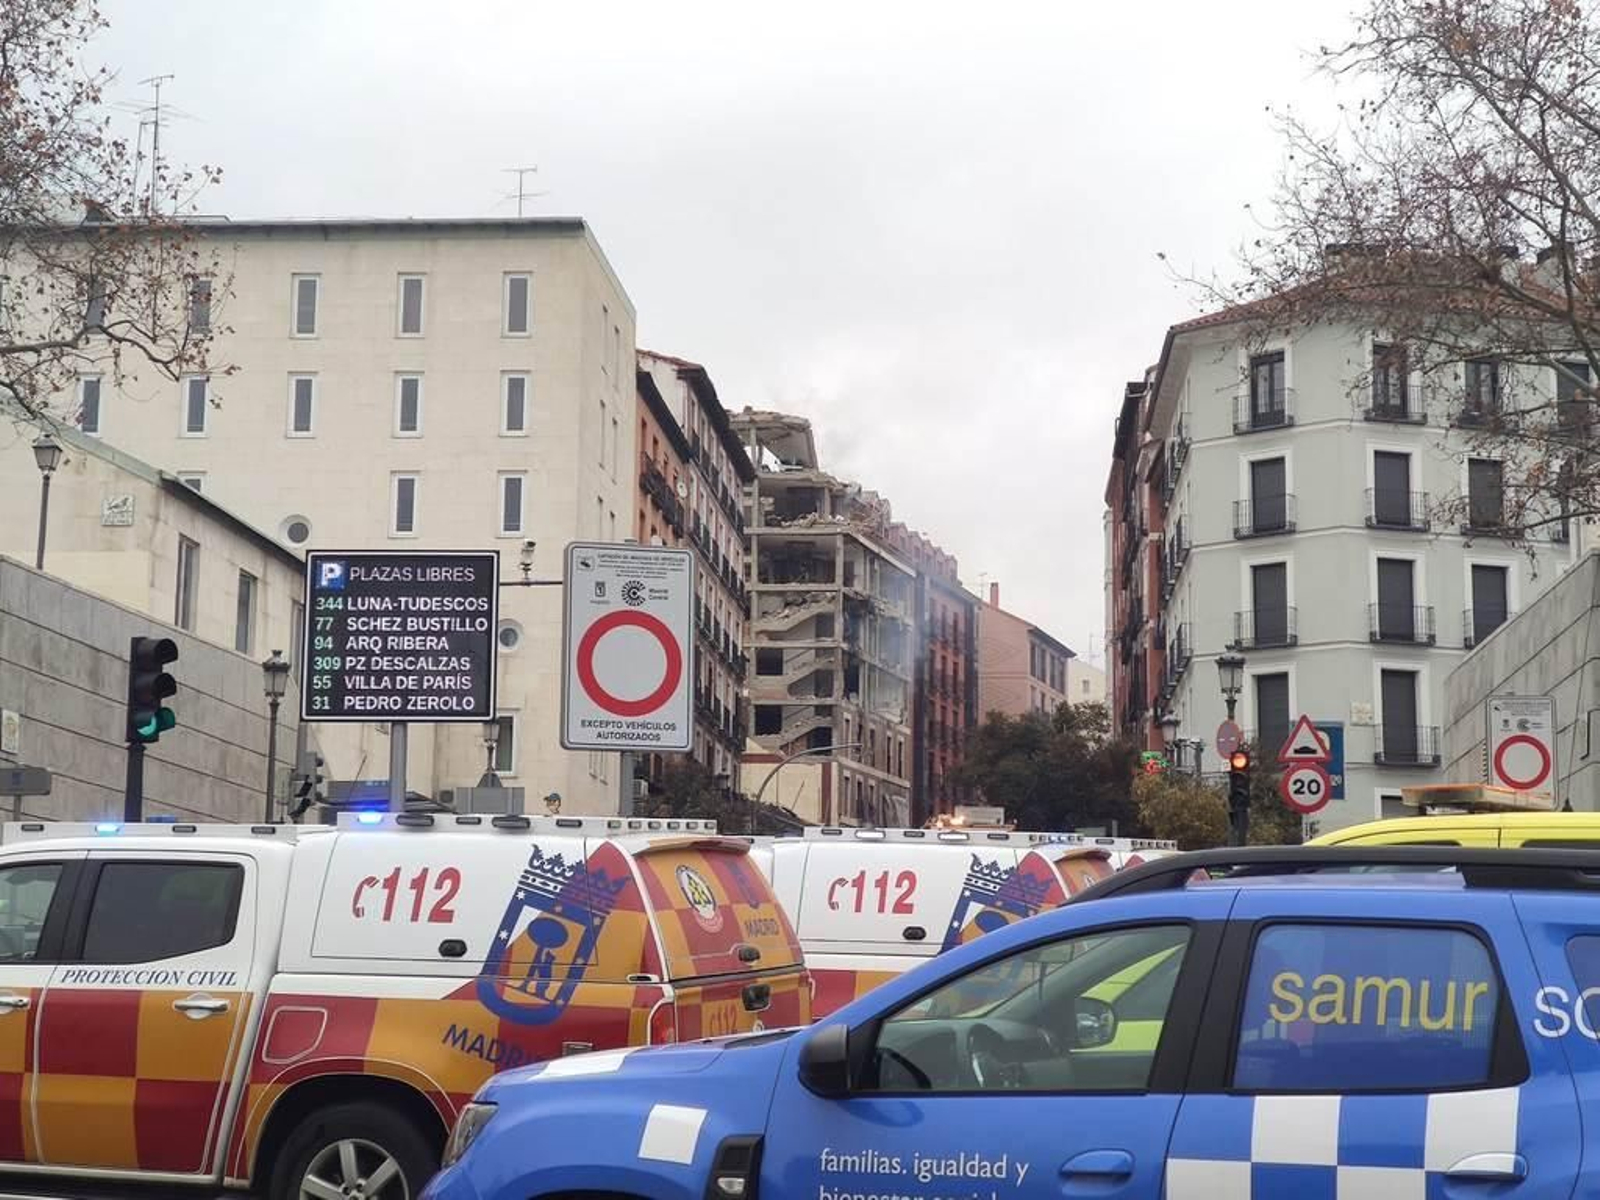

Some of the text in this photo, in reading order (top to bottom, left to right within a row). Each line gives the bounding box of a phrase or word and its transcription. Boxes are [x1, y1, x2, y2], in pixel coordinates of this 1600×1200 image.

[321, 563, 475, 587] P PLAZAS LIBRES
[315, 597, 489, 611] 344 LUNA-TUDESCOS
[315, 617, 488, 632] 77 SCHEZ BUSTILLO
[314, 636, 449, 654] 94 ARQ RIBERA
[313, 657, 471, 670] 309 PZ DESCALZAS
[312, 672, 472, 689] 55 VILLA DE PARÍS
[312, 696, 476, 710] 31 PEDRO ZEROLO
[580, 719, 624, 729] EXCEPTO
[596, 731, 662, 741] AUTORIZADOS
[1292, 778, 1321, 795] 20
[381, 866, 461, 923] 112
[851, 869, 918, 915] 112
[61, 969, 238, 986] PROTECCION CIVIL
[1269, 971, 1488, 1032] samur
[913, 1152, 1008, 1183] igualdad
[1015, 1161, 1030, 1187] y
